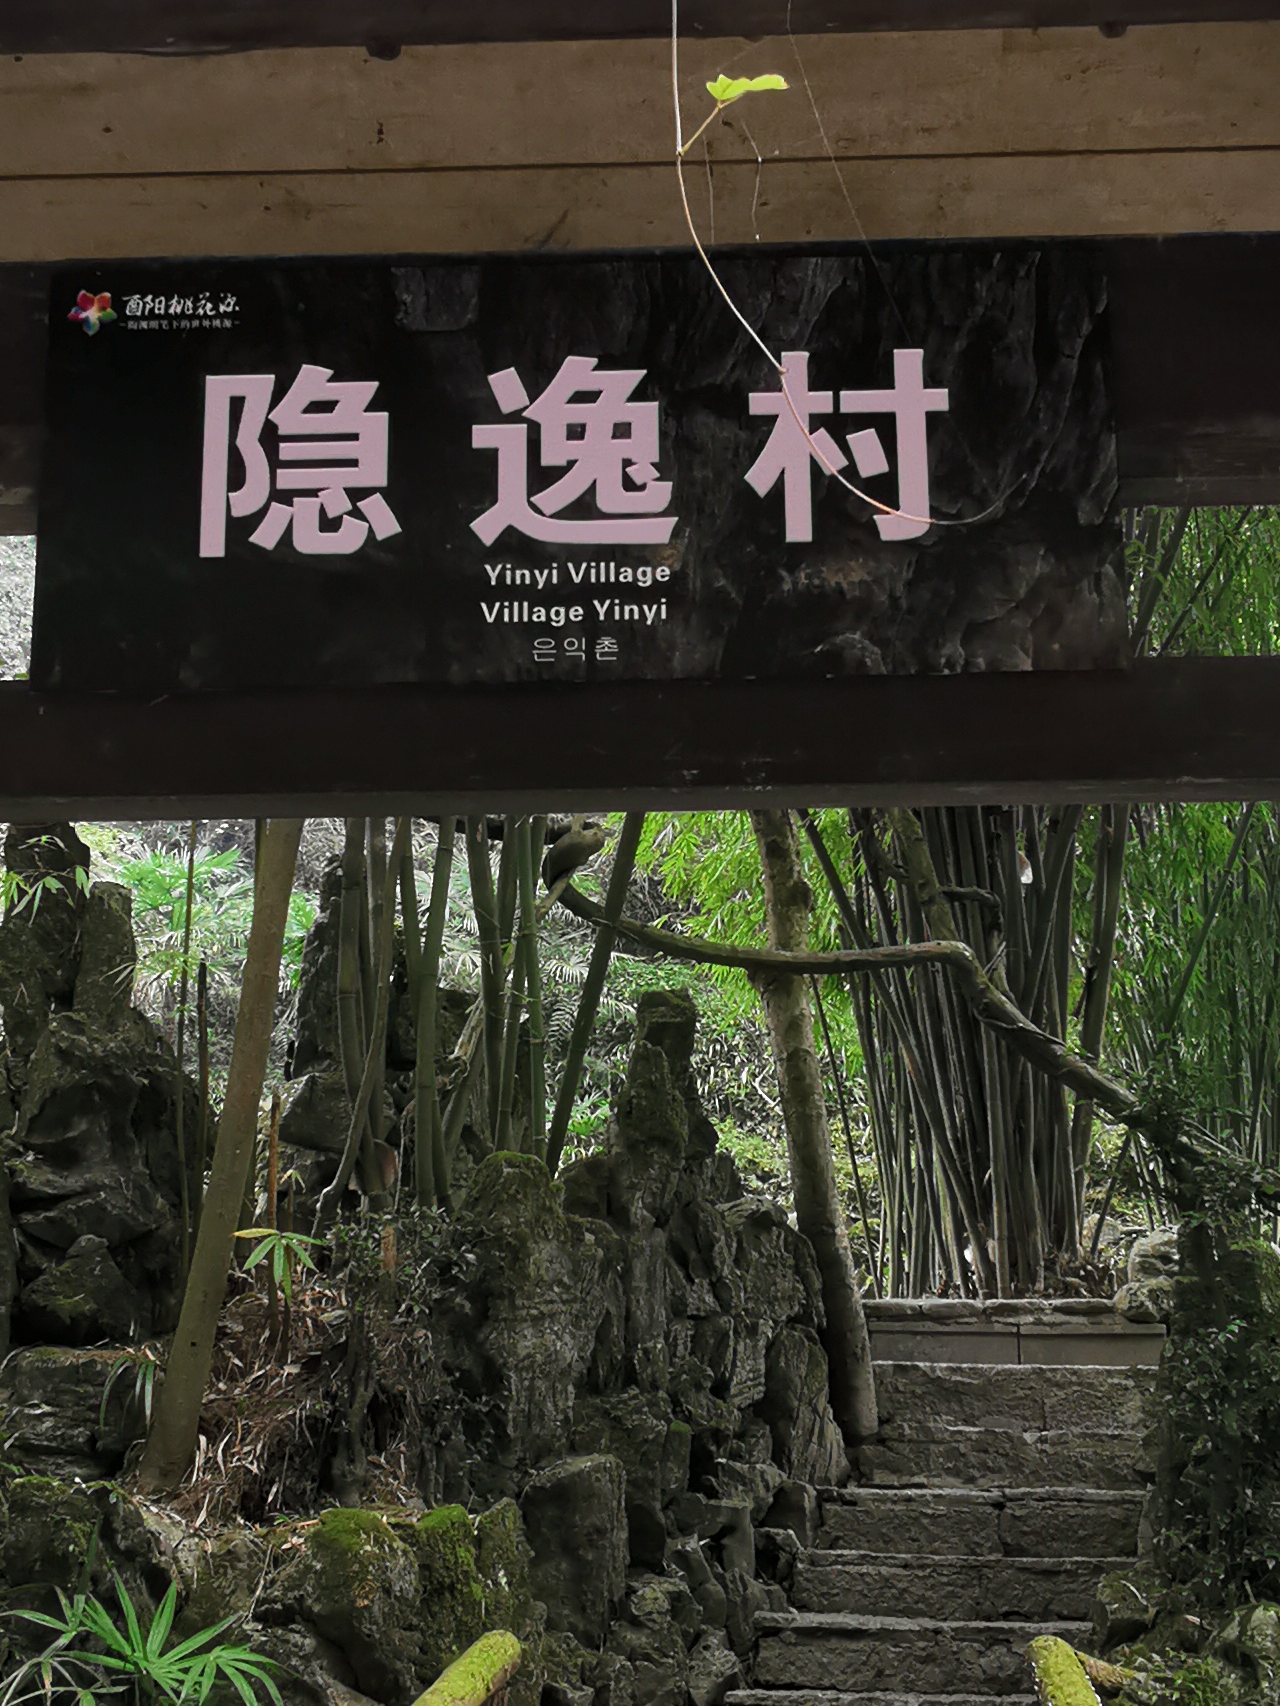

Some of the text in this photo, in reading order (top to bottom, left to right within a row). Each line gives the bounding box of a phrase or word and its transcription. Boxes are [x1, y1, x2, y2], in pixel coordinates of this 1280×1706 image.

[198, 348, 950, 558] 隐逸村
[484, 561, 671, 590] Yinyi Village
[480, 598, 667, 627] Village Yinyi
[532, 636, 619, 662] 은익촌
